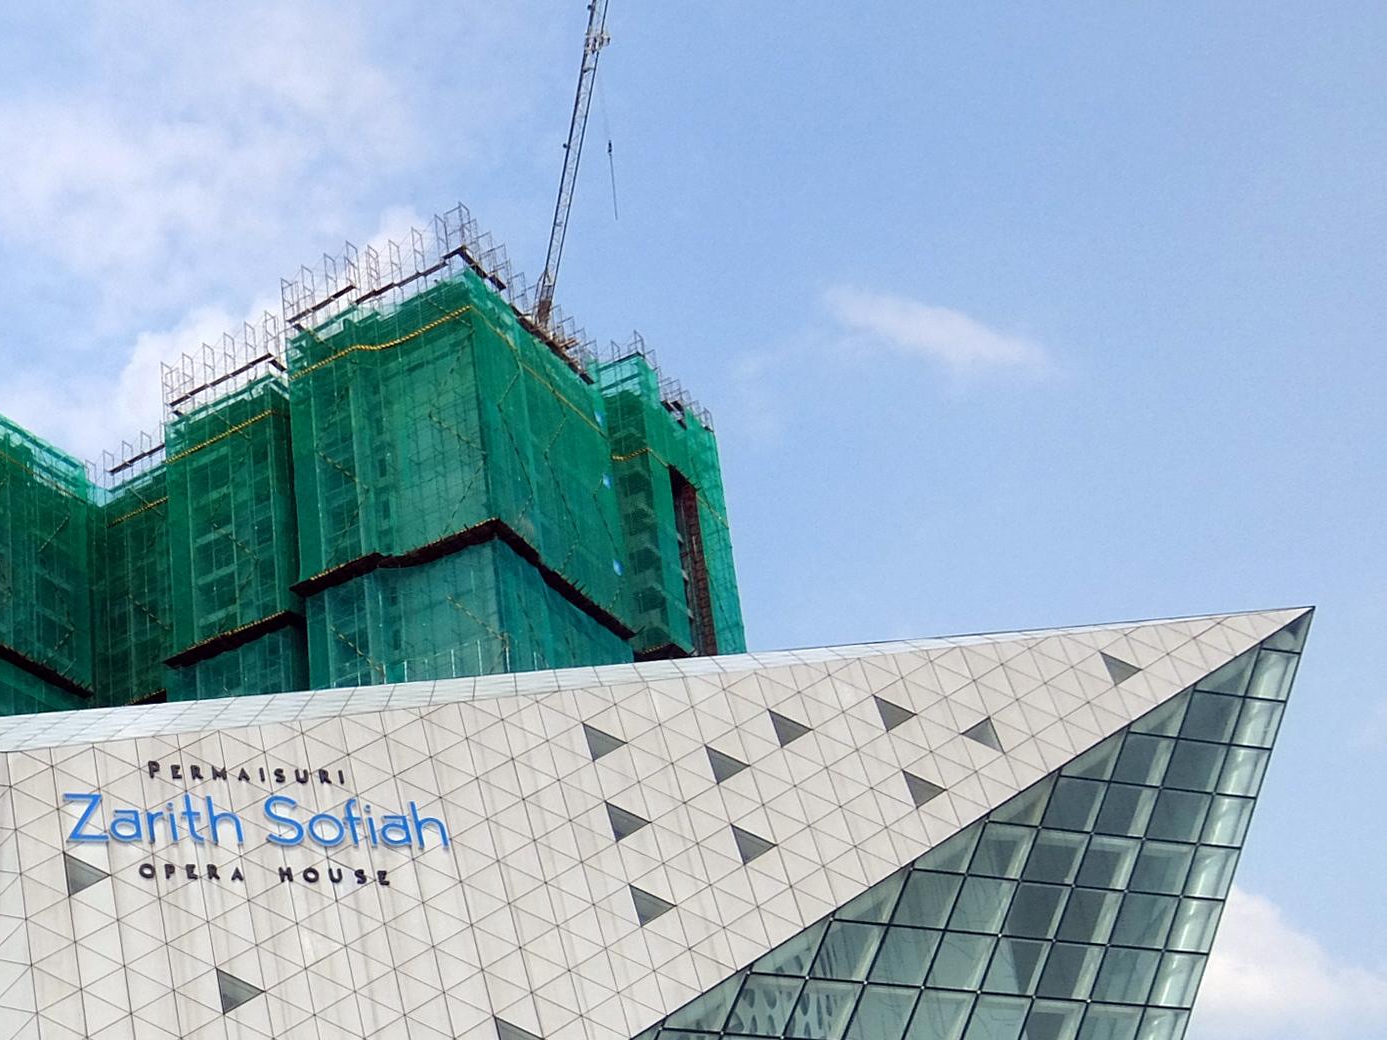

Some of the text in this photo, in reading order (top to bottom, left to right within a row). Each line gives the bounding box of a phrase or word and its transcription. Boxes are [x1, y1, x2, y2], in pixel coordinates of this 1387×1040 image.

[148, 761, 345, 785] PERMAISURI
[63, 793, 450, 850] Zarith Sofiah
[138, 863, 391, 886] OPERA HOUSE
